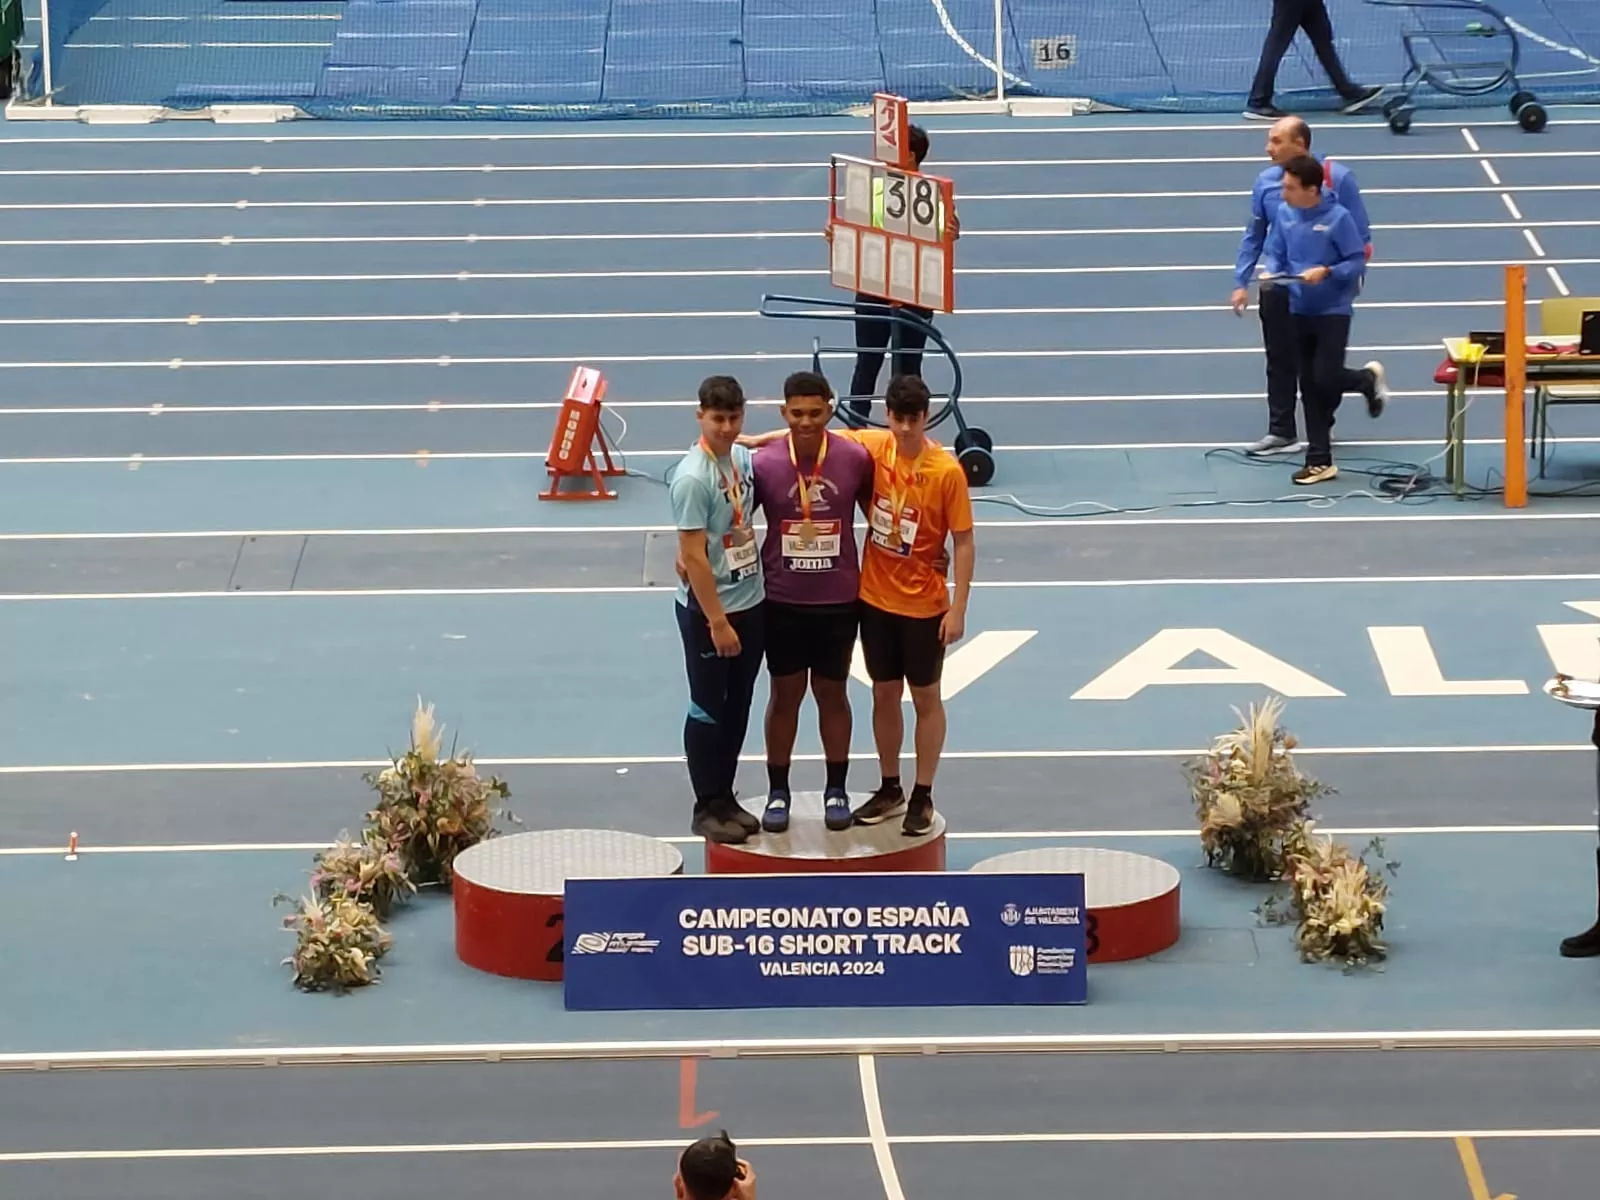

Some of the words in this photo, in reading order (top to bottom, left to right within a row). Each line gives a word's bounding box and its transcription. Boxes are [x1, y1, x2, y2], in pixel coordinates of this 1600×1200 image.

[1039, 43, 1070, 62] 16
[886, 172, 934, 225] 38
[558, 409, 581, 460] MONDO
[679, 907, 862, 930] CAMPEONATO
[867, 901, 970, 928] ESPAÑA
[682, 934, 775, 957] SUB-16
[779, 934, 868, 956] SHORT
[872, 933, 963, 955] TRACK
[760, 961, 840, 977] VALENCIA
[842, 960, 885, 976] 2024
